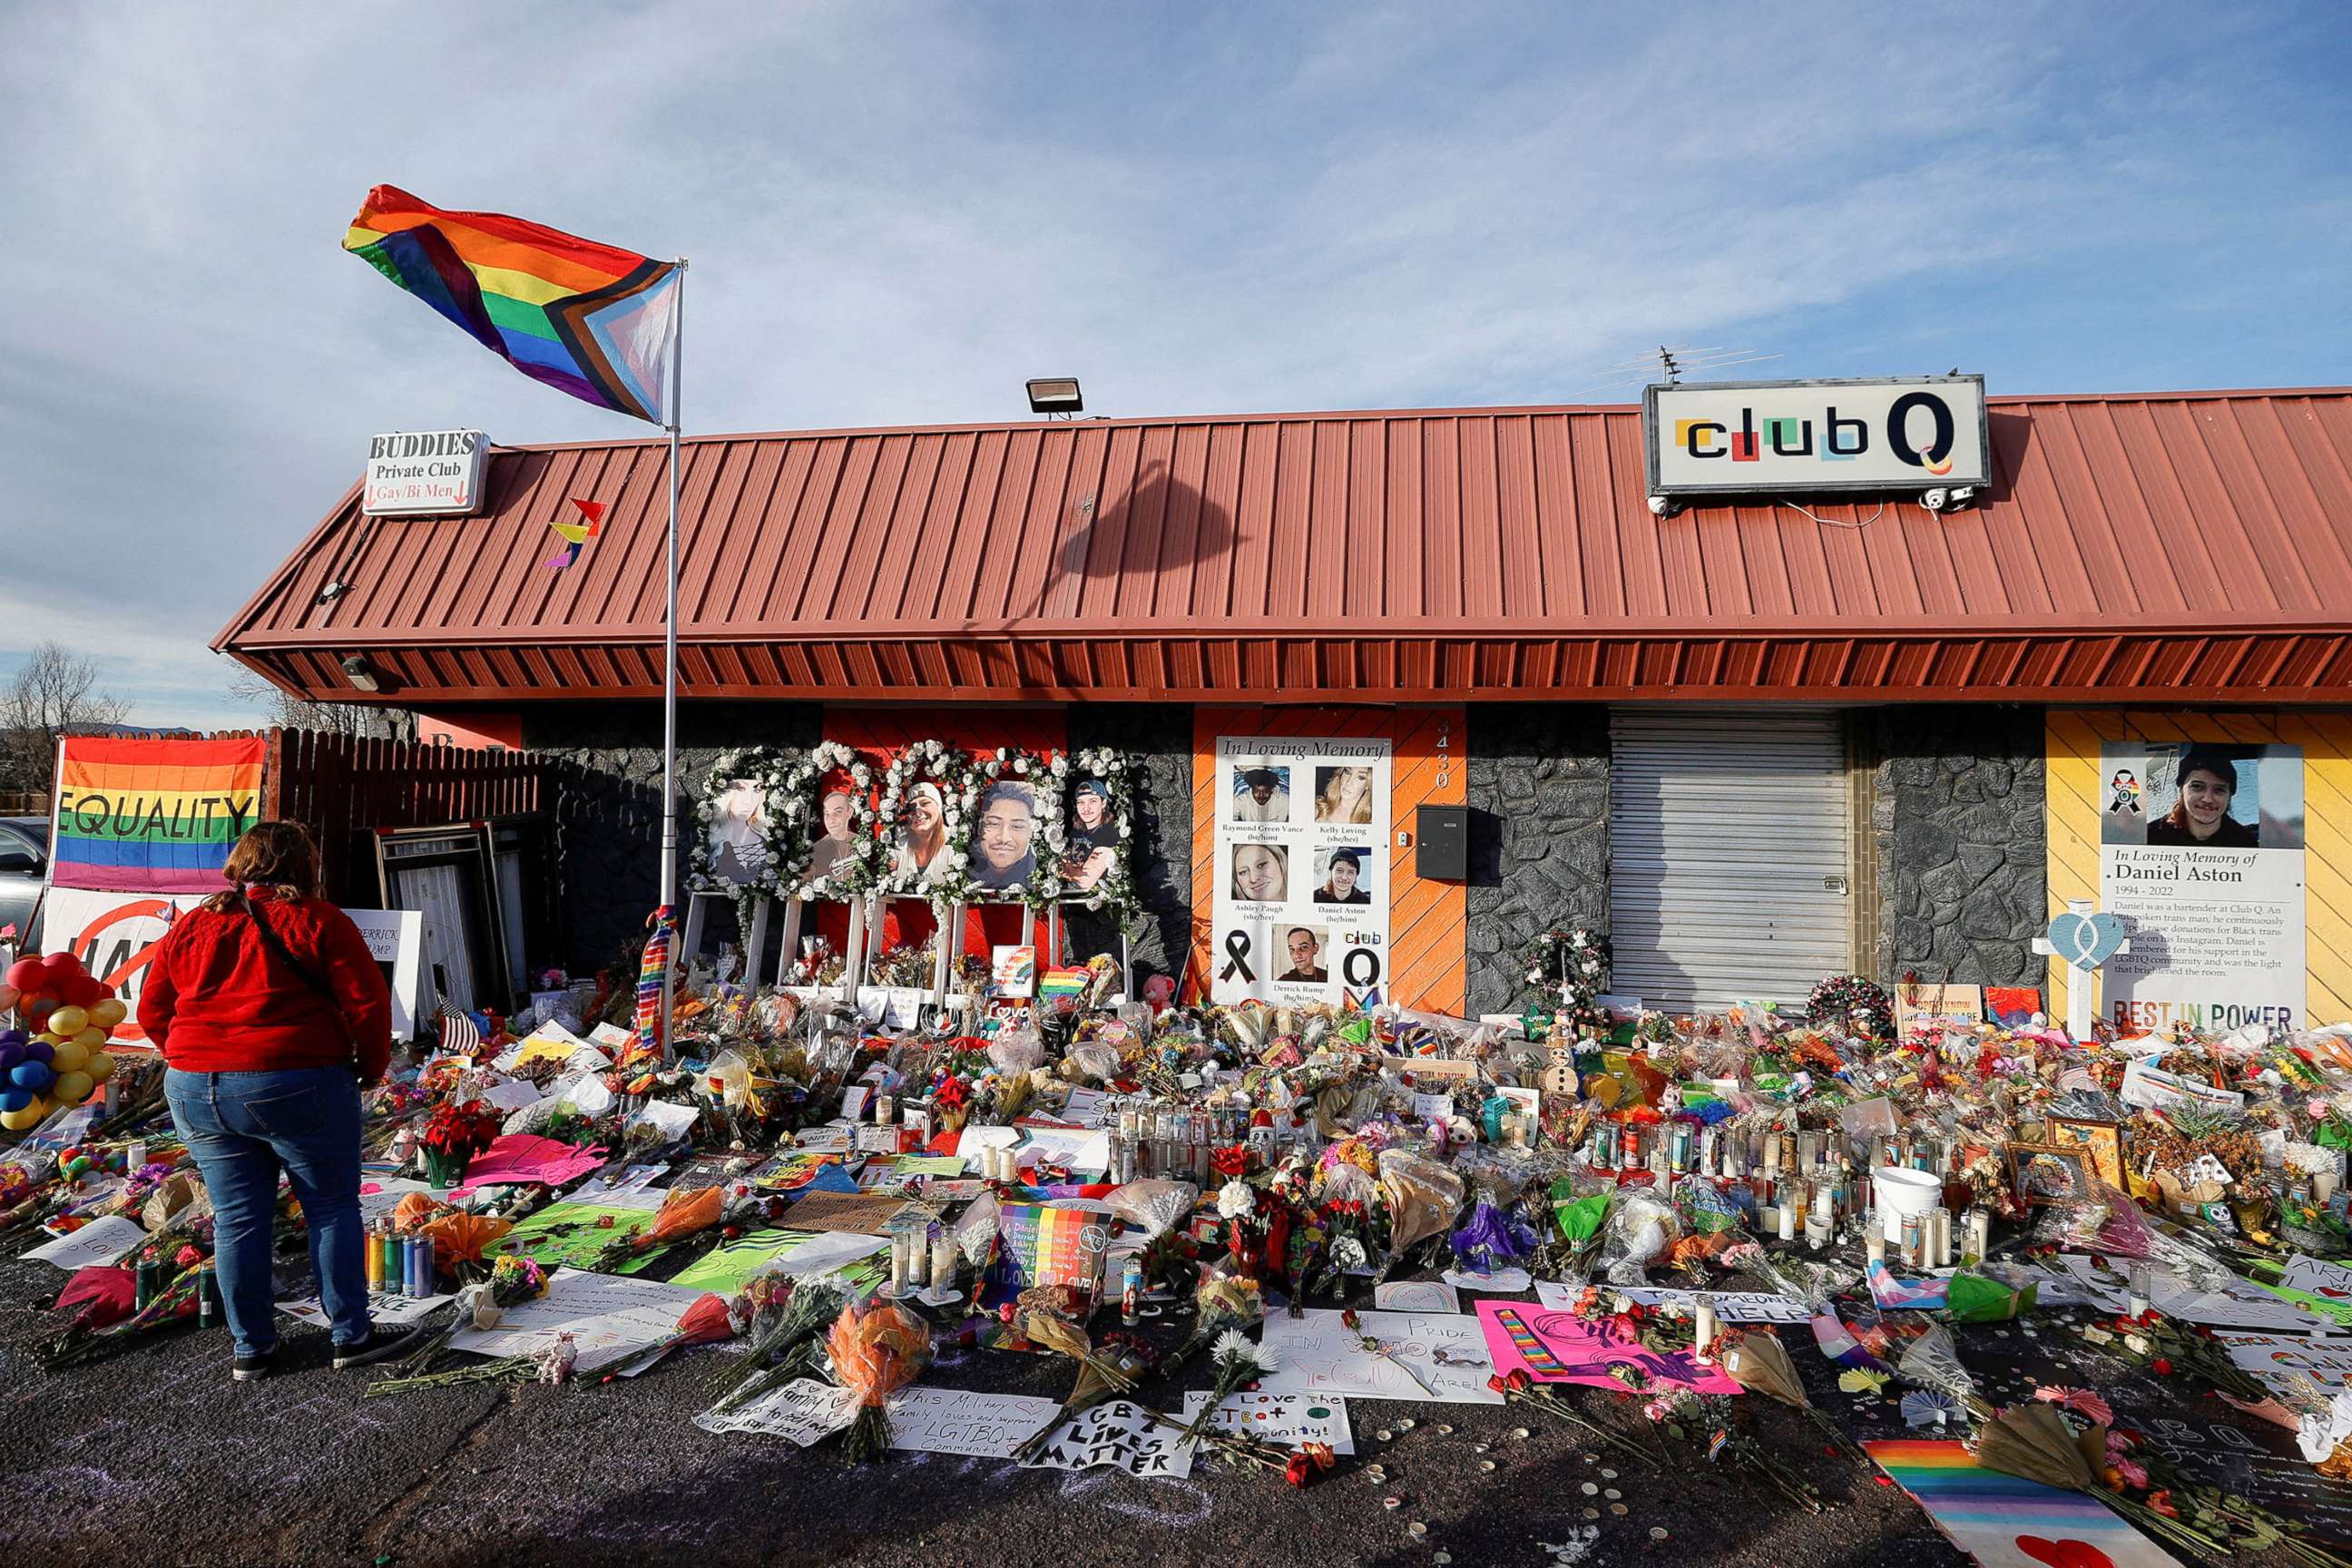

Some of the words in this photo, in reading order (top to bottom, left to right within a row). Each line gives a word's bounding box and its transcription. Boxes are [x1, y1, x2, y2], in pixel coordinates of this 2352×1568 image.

[1687, 406, 1869, 459] club
[1886, 391, 1955, 475] Q
[369, 431, 476, 459] BUDDIES
[376, 464, 424, 479] Private
[428, 461, 461, 476] Club
[377, 484, 421, 502] Gay/Bi
[426, 484, 453, 497] Men
[1223, 740, 1241, 756] In
[1247, 740, 1308, 761] Loving
[1311, 741, 1386, 762] Memory
[58, 791, 254, 838] EQUALITY
[1222, 824, 1257, 833] Raymond
[1258, 825, 1280, 833] Green
[1319, 827, 1339, 835] Kelly
[1341, 827, 1367, 836] Loving
[2114, 849, 2129, 861] In
[2132, 849, 2180, 866] Loving
[2183, 851, 2239, 867] Memory
[2243, 852, 2259, 867] of
[2115, 864, 2180, 880] Daniel
[2187, 866, 2243, 883] Aston
[2114, 885, 2139, 896] 1994
[2149, 886, 2173, 897] 2022
[1235, 904, 1259, 913] Ashley
[1260, 905, 1284, 914] Paugh
[1318, 906, 1343, 915] Daniel
[2114, 901, 2144, 910] Daniel
[2173, 903, 2217, 913] bartender
[2220, 905, 2228, 913] at
[2230, 905, 2252, 914] Club
[2268, 906, 2281, 915] An
[2163, 915, 2186, 923] trans
[2189, 916, 2210, 925] man,
[2213, 915, 2224, 924] he
[2225, 916, 2285, 926] continuously
[1346, 930, 1381, 946] club
[2147, 925, 2169, 933] raise
[2171, 925, 2215, 934] donations
[2217, 926, 2230, 934] for
[2232, 926, 2257, 936] Black
[2259, 927, 2282, 936] trans
[2161, 935, 2173, 943] his
[2176, 936, 2223, 946] Instagram.
[2226, 937, 2255, 946] Daniel
[2172, 946, 2186, 955] for
[2189, 946, 2202, 955] his
[2203, 947, 2239, 957] support
[2242, 948, 2252, 956] in
[2255, 949, 2267, 957] the
[1343, 947, 1381, 987] Q
[2114, 965, 2132, 974] that
[2133, 965, 2183, 977] brightened
[2185, 967, 2198, 975] the
[2201, 969, 2229, 977] room.
[2150, 956, 2201, 967] community
[2204, 957, 2221, 966] and
[2223, 959, 2241, 967] was
[2243, 958, 2258, 967] the
[2260, 959, 2282, 970] light
[1273, 984, 1300, 993] Derrick
[1302, 985, 1326, 995] Rump
[2180, 1002, 2203, 1027] IN
[2211, 1004, 2292, 1032] POWER
[1082, 1232, 1103, 1247] HATE
[1644, 1289, 1677, 1299] TO
[1408, 1318, 1475, 1340] PRIDE
[779, 1387, 824, 1416] family
[899, 1388, 942, 1406] This
[951, 1393, 1009, 1414] Military
[1189, 1394, 1209, 1404] W
[1240, 1394, 1297, 1405] Love
[767, 1406, 781, 1420] to
[889, 1405, 932, 1421] Family
[940, 1408, 972, 1421] loves
[977, 1414, 993, 1423] and
[997, 1415, 1036, 1425] supports
[924, 1420, 1018, 1445] LGTBQ+
[921, 1438, 999, 1455] Community
[1030, 1441, 1170, 1475] MATTER
